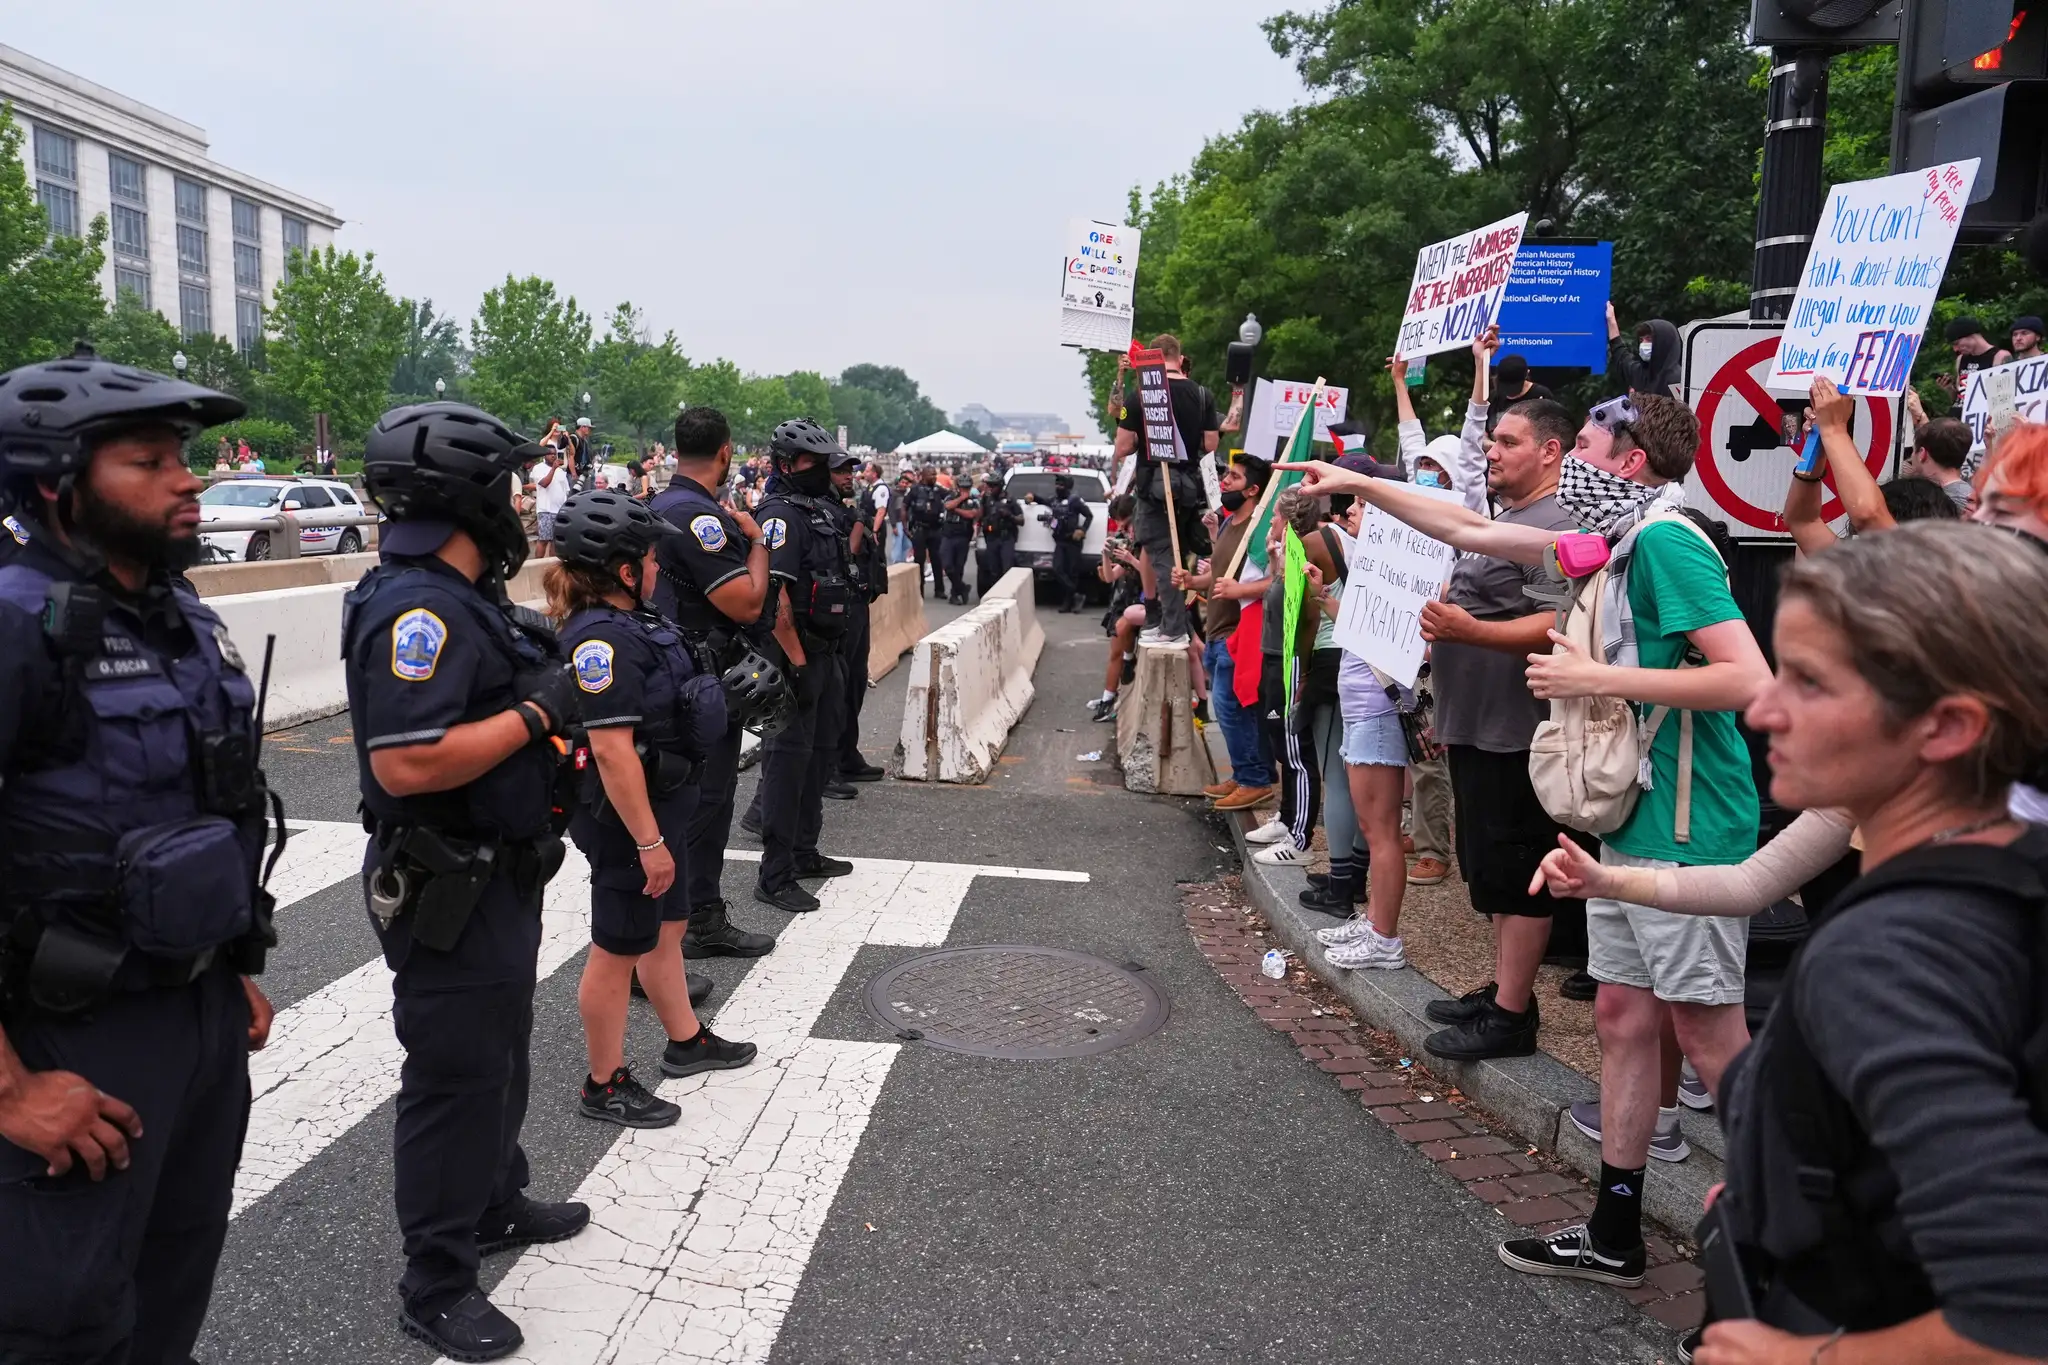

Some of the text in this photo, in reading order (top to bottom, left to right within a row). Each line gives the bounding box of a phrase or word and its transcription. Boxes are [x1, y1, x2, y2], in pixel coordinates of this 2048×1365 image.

[1943, 165, 1963, 194] Free
[1830, 195, 1869, 244] You
[1932, 190, 1959, 229] people
[1419, 226, 1519, 282] WHEN THE LAWMAKERS
[1539, 251, 1576, 259] Museums
[1546, 260, 1573, 269] History
[1808, 251, 1845, 288] talk
[1850, 256, 1892, 288] about
[1404, 252, 1513, 315] ARE THE LAWBREAKERS
[1510, 268, 1601, 277] African American History
[1538, 277, 1565, 286] History
[1532, 295, 1558, 304] Gallery
[1846, 300, 1886, 325] when
[1889, 302, 1921, 331] you
[1400, 319, 1428, 352] THERE
[1429, 322, 1439, 340] IS
[1439, 302, 1467, 344] NO
[1844, 329, 1921, 391] FELON
[1142, 371, 1162, 385] NO TO
[1144, 407, 1168, 421] FASCIST
[1146, 425, 1173, 440] MILITARY
[1367, 524, 1384, 546] FOR
[1390, 528, 1403, 548] MY
[1405, 530, 1445, 564] FREEDOM
[1354, 555, 1441, 601] WHILE LIVING UNDER A
[1349, 584, 1422, 654] TYRANT!
